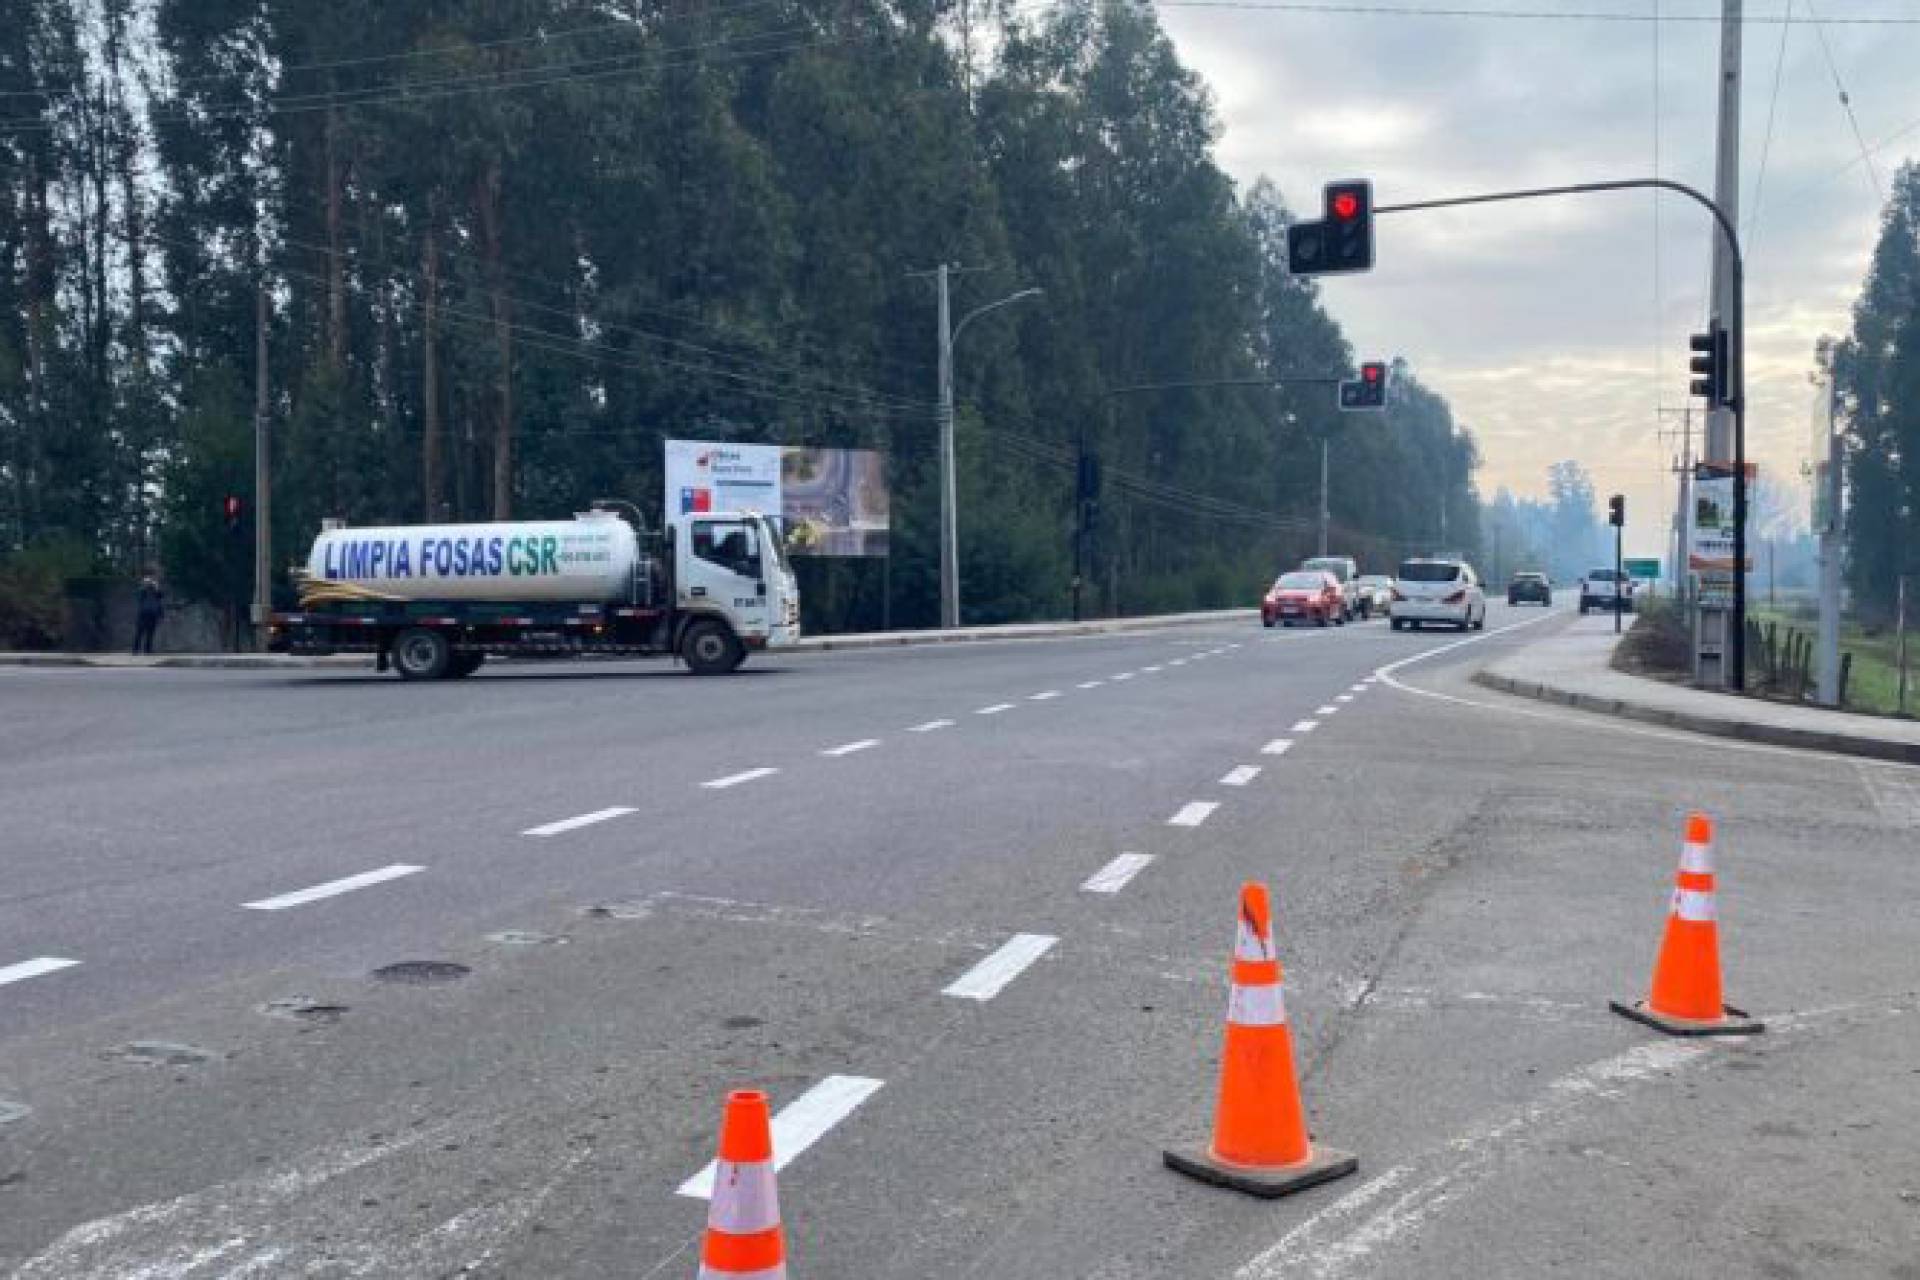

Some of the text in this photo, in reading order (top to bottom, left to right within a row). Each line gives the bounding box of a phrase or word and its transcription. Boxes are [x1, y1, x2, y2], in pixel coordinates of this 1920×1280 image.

[324, 536, 559, 579] LIMPIA FOSAS CSR
